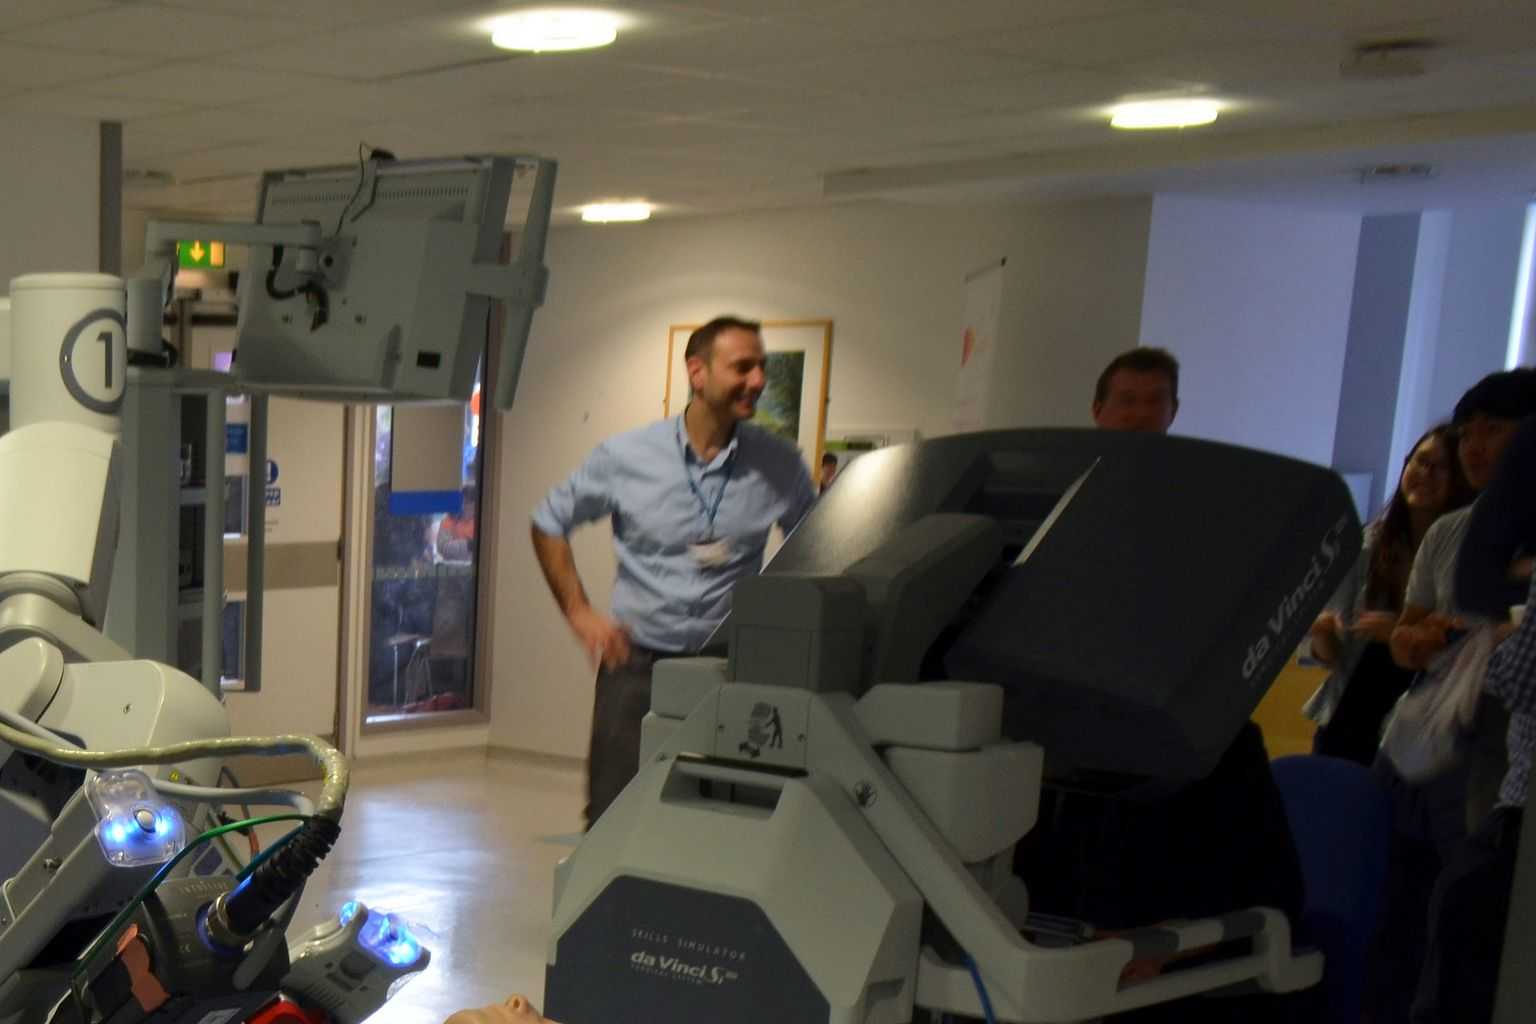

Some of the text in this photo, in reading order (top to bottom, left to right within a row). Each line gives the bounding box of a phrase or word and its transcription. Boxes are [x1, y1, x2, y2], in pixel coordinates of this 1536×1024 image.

[95, 331, 113, 390] 1
[1241, 635, 1272, 680] da
[1267, 555, 1322, 634] Vinci
[630, 951, 657, 966] da
[658, 955, 707, 978] Vinci
